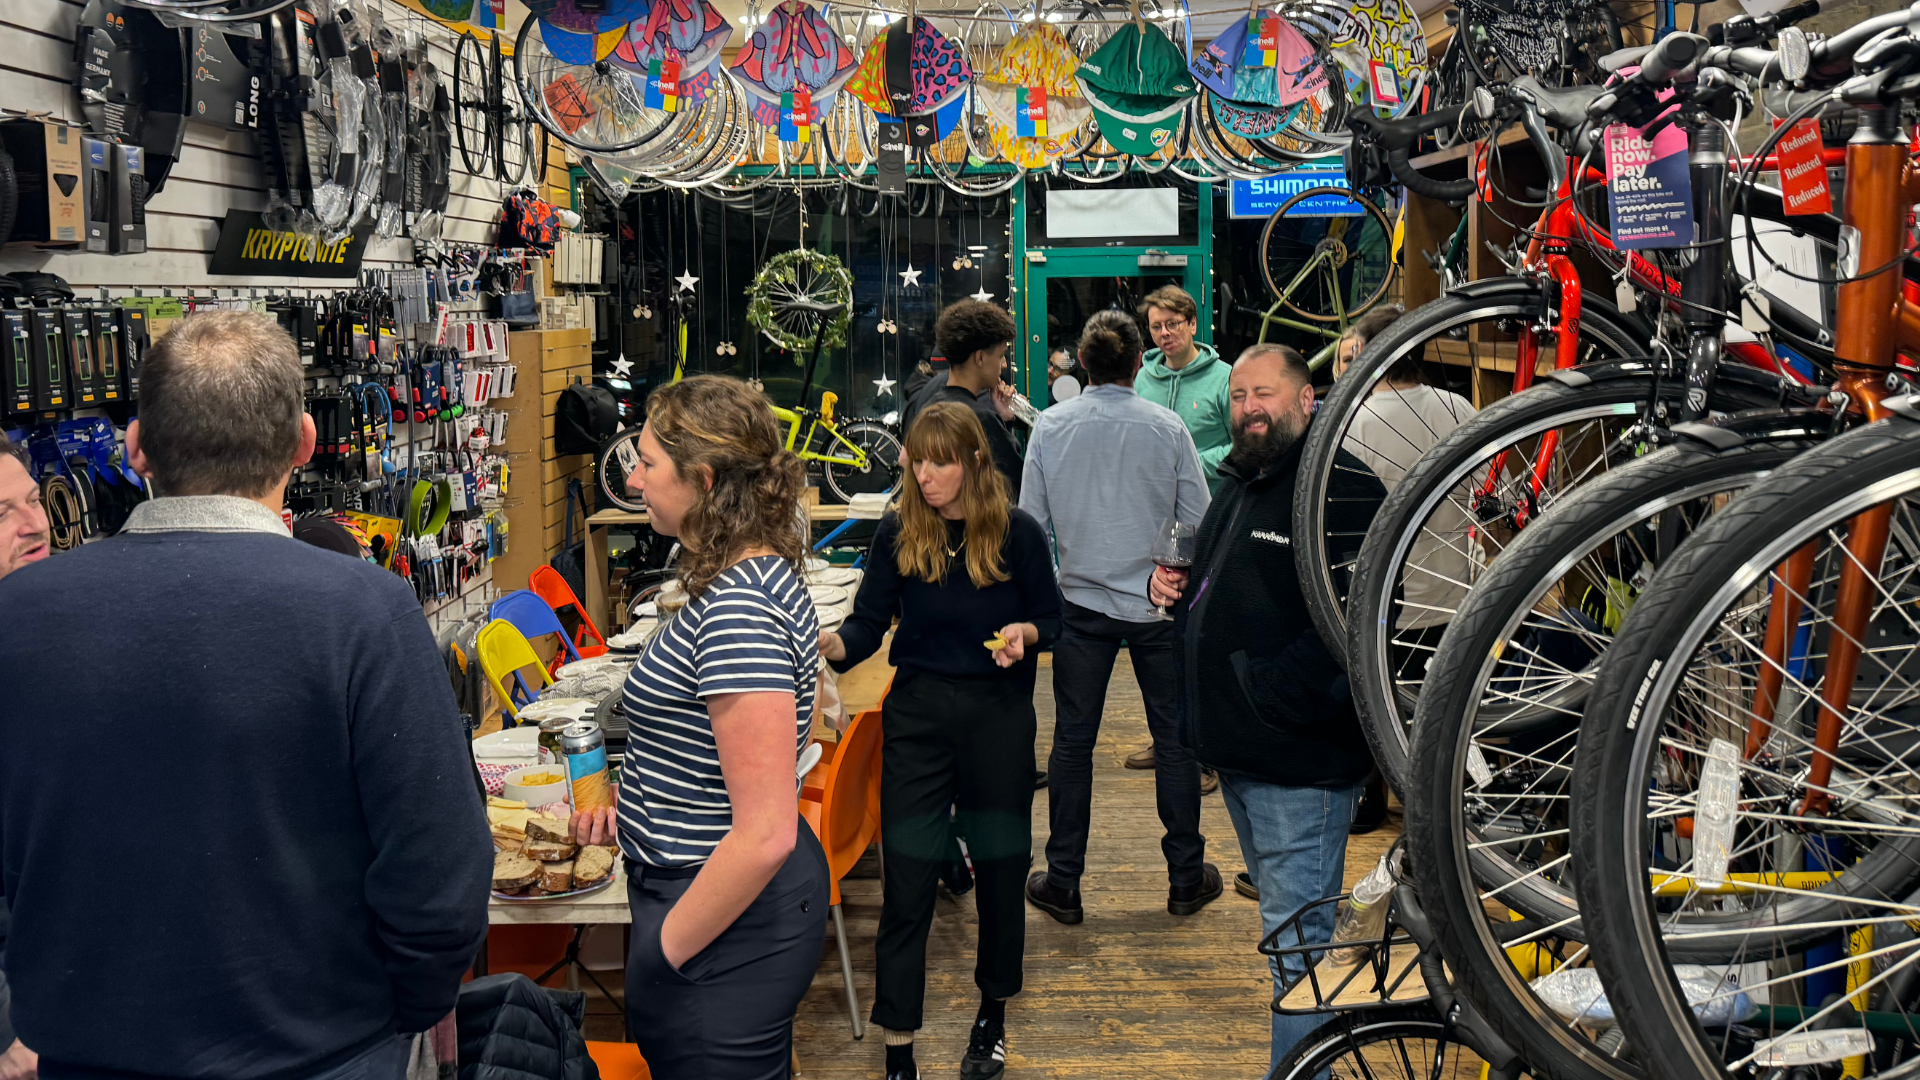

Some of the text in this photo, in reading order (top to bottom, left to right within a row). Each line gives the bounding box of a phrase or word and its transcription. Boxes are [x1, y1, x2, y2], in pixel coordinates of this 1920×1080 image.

[93, 47, 109, 59] MADE
[96, 57, 104, 66] IN
[85, 62, 112, 78] GERMANY
[248, 76, 260, 129] LONG
[1610, 136, 1654, 152] Ride
[1780, 128, 1818, 153] Reduced
[1611, 150, 1656, 163] now.
[1612, 163, 1647, 179] Pay
[1783, 154, 1822, 180] Reduced
[1612, 176, 1662, 193] later.
[1787, 181, 1826, 208] Reduced
[1634, 677, 1652, 707] TIRE
